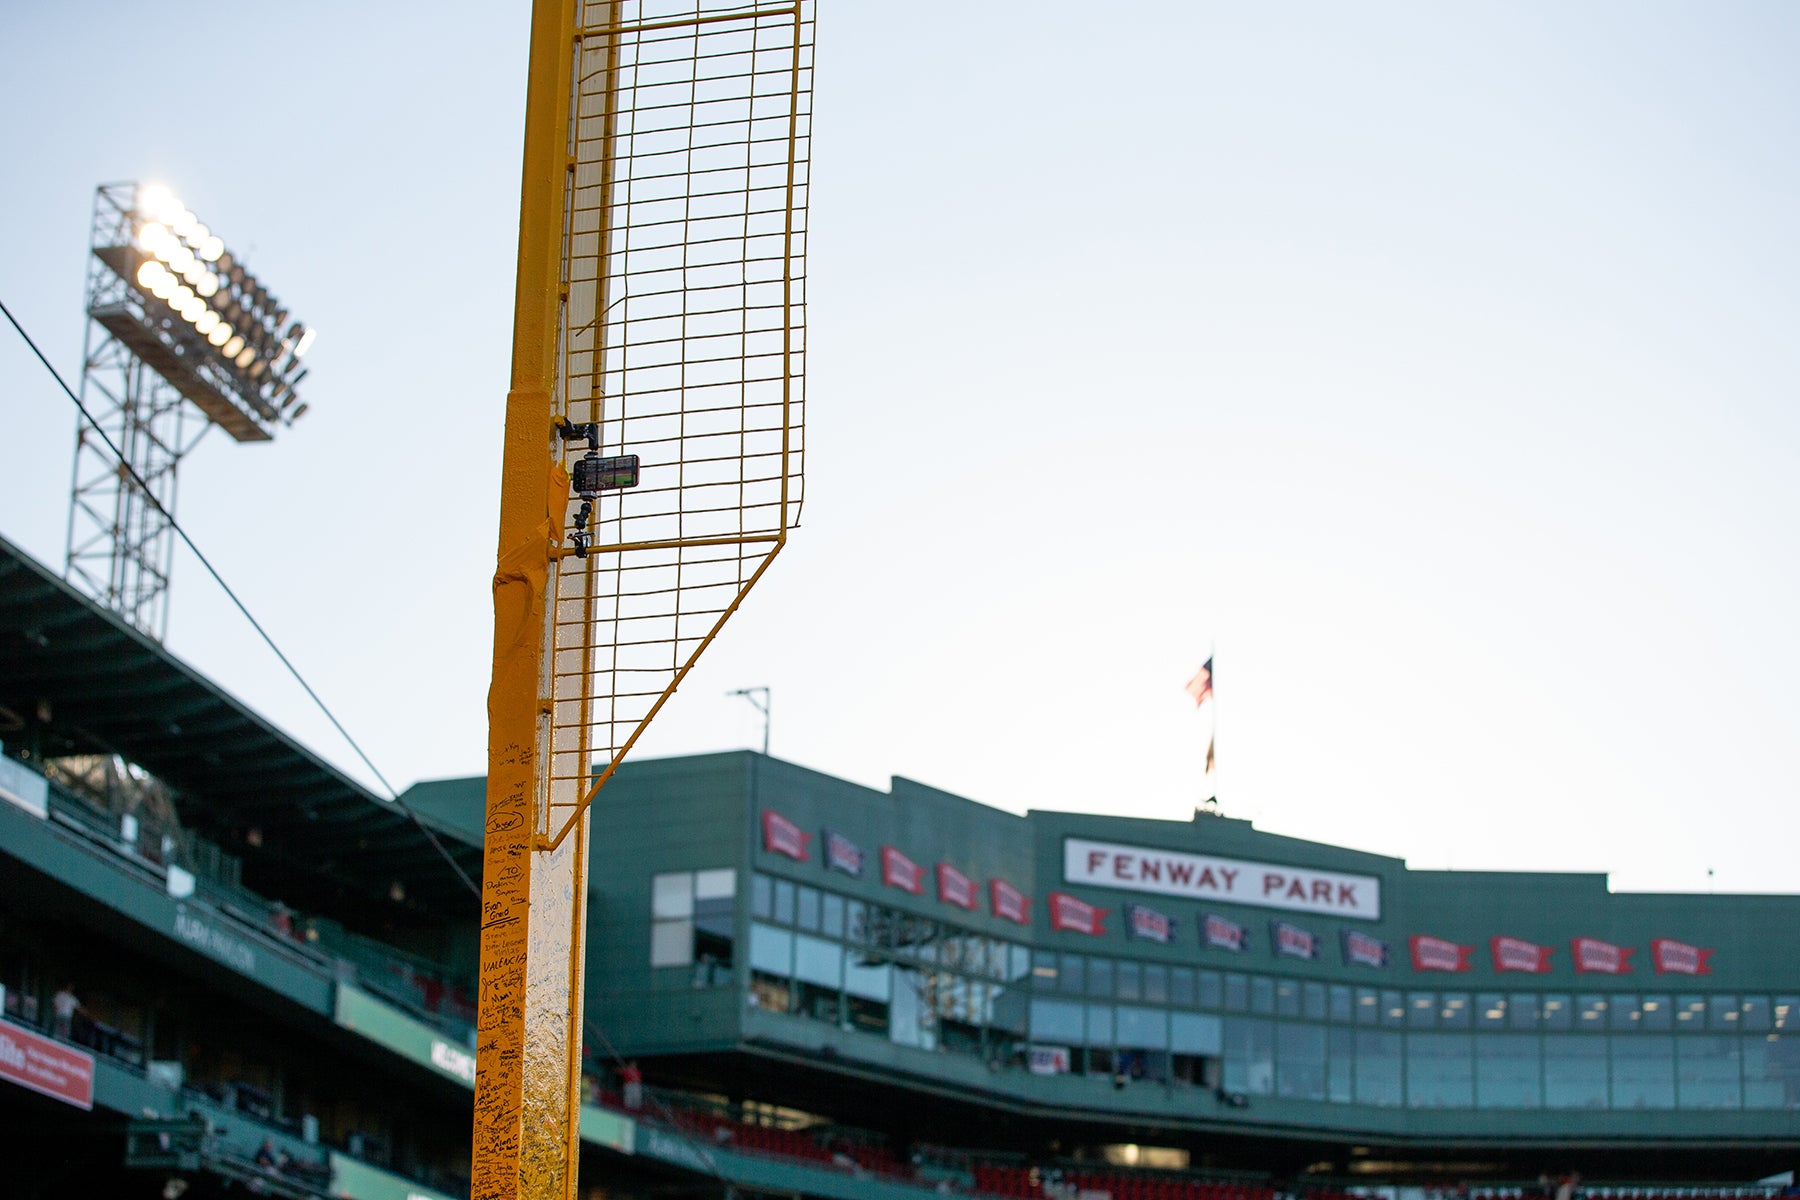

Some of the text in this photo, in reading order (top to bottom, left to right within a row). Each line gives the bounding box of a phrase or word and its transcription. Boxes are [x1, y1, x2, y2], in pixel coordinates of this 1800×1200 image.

[1086, 851, 1359, 907] FENWAY PARK
[483, 952, 527, 972] VALENCIA
